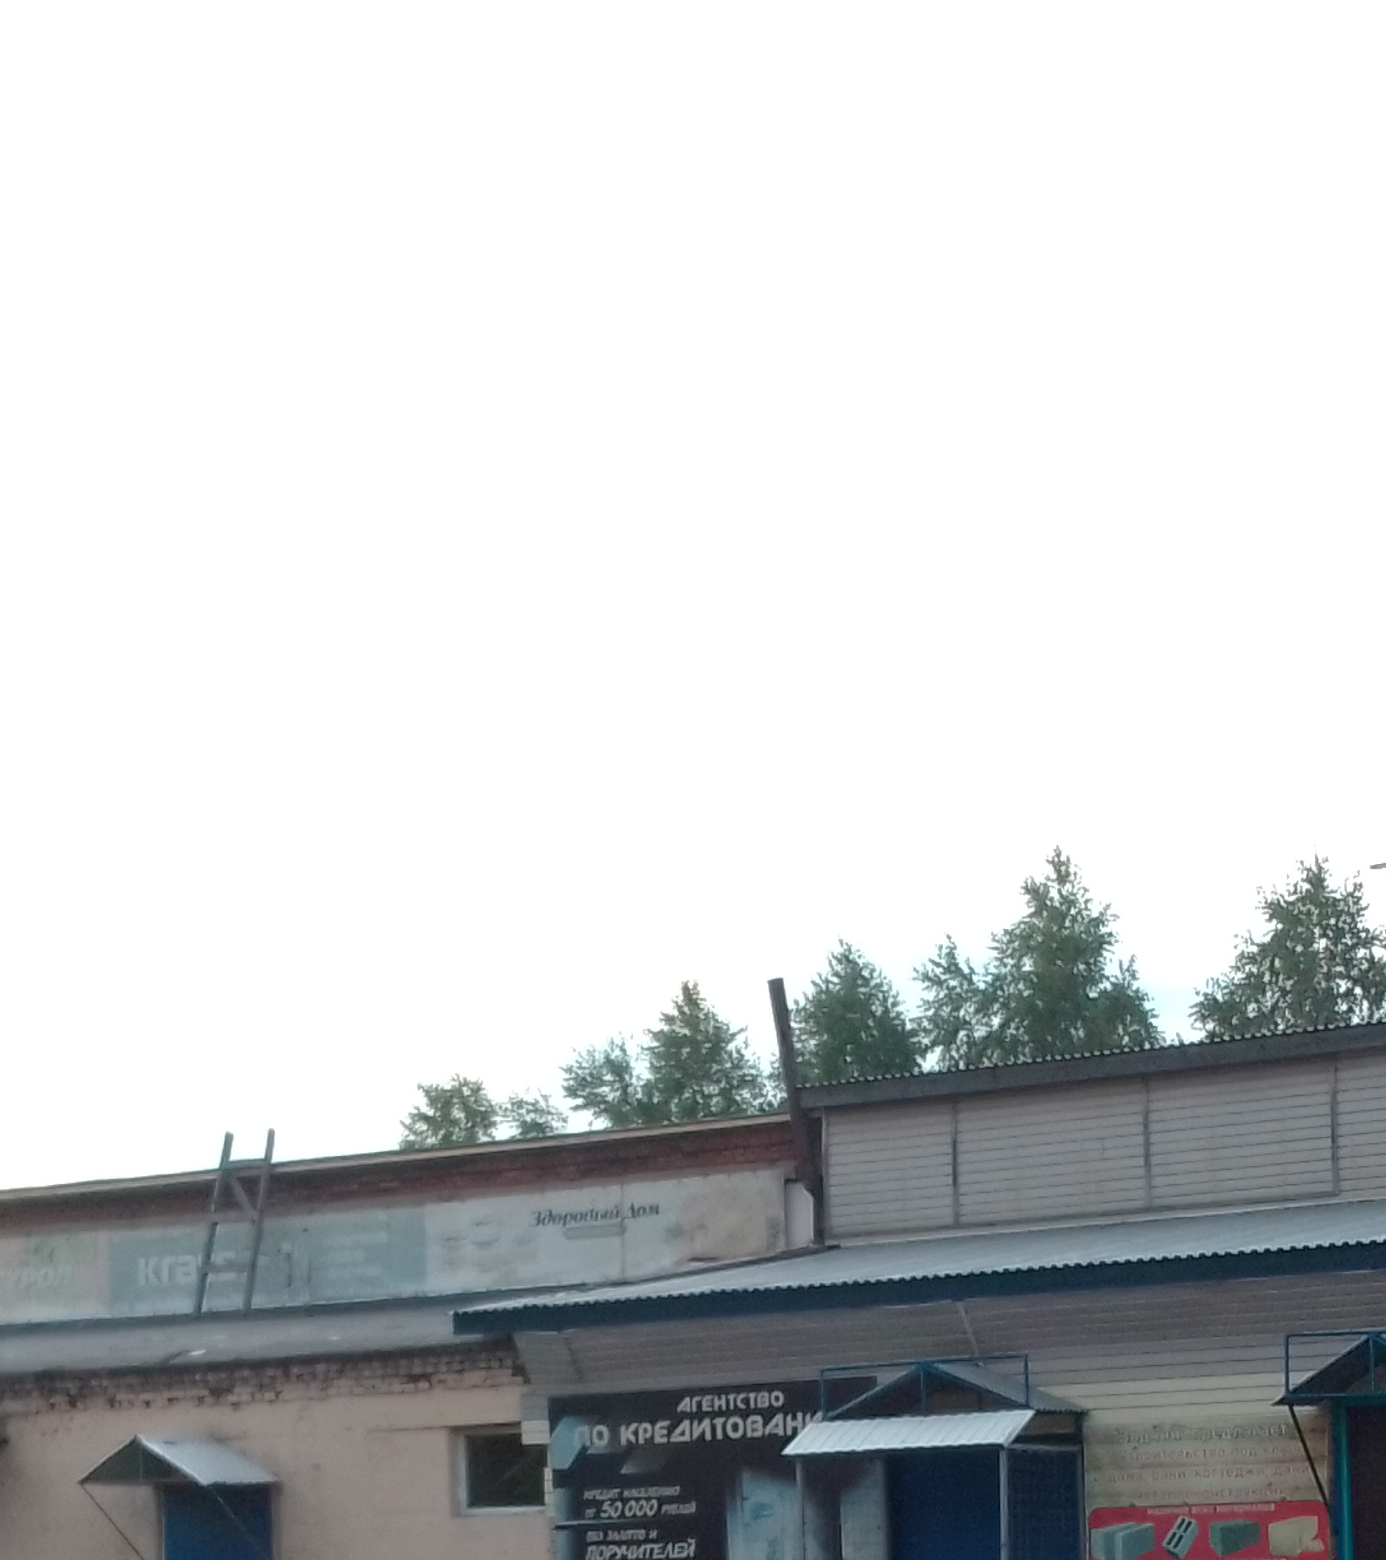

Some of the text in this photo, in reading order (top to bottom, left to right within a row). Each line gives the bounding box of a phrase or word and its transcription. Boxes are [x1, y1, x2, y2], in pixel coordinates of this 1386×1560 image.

[676, 1390, 785, 1413] АГЕНТСТВО
[574, 1411, 824, 1447] ПО КРЕДИТОВАНИ
